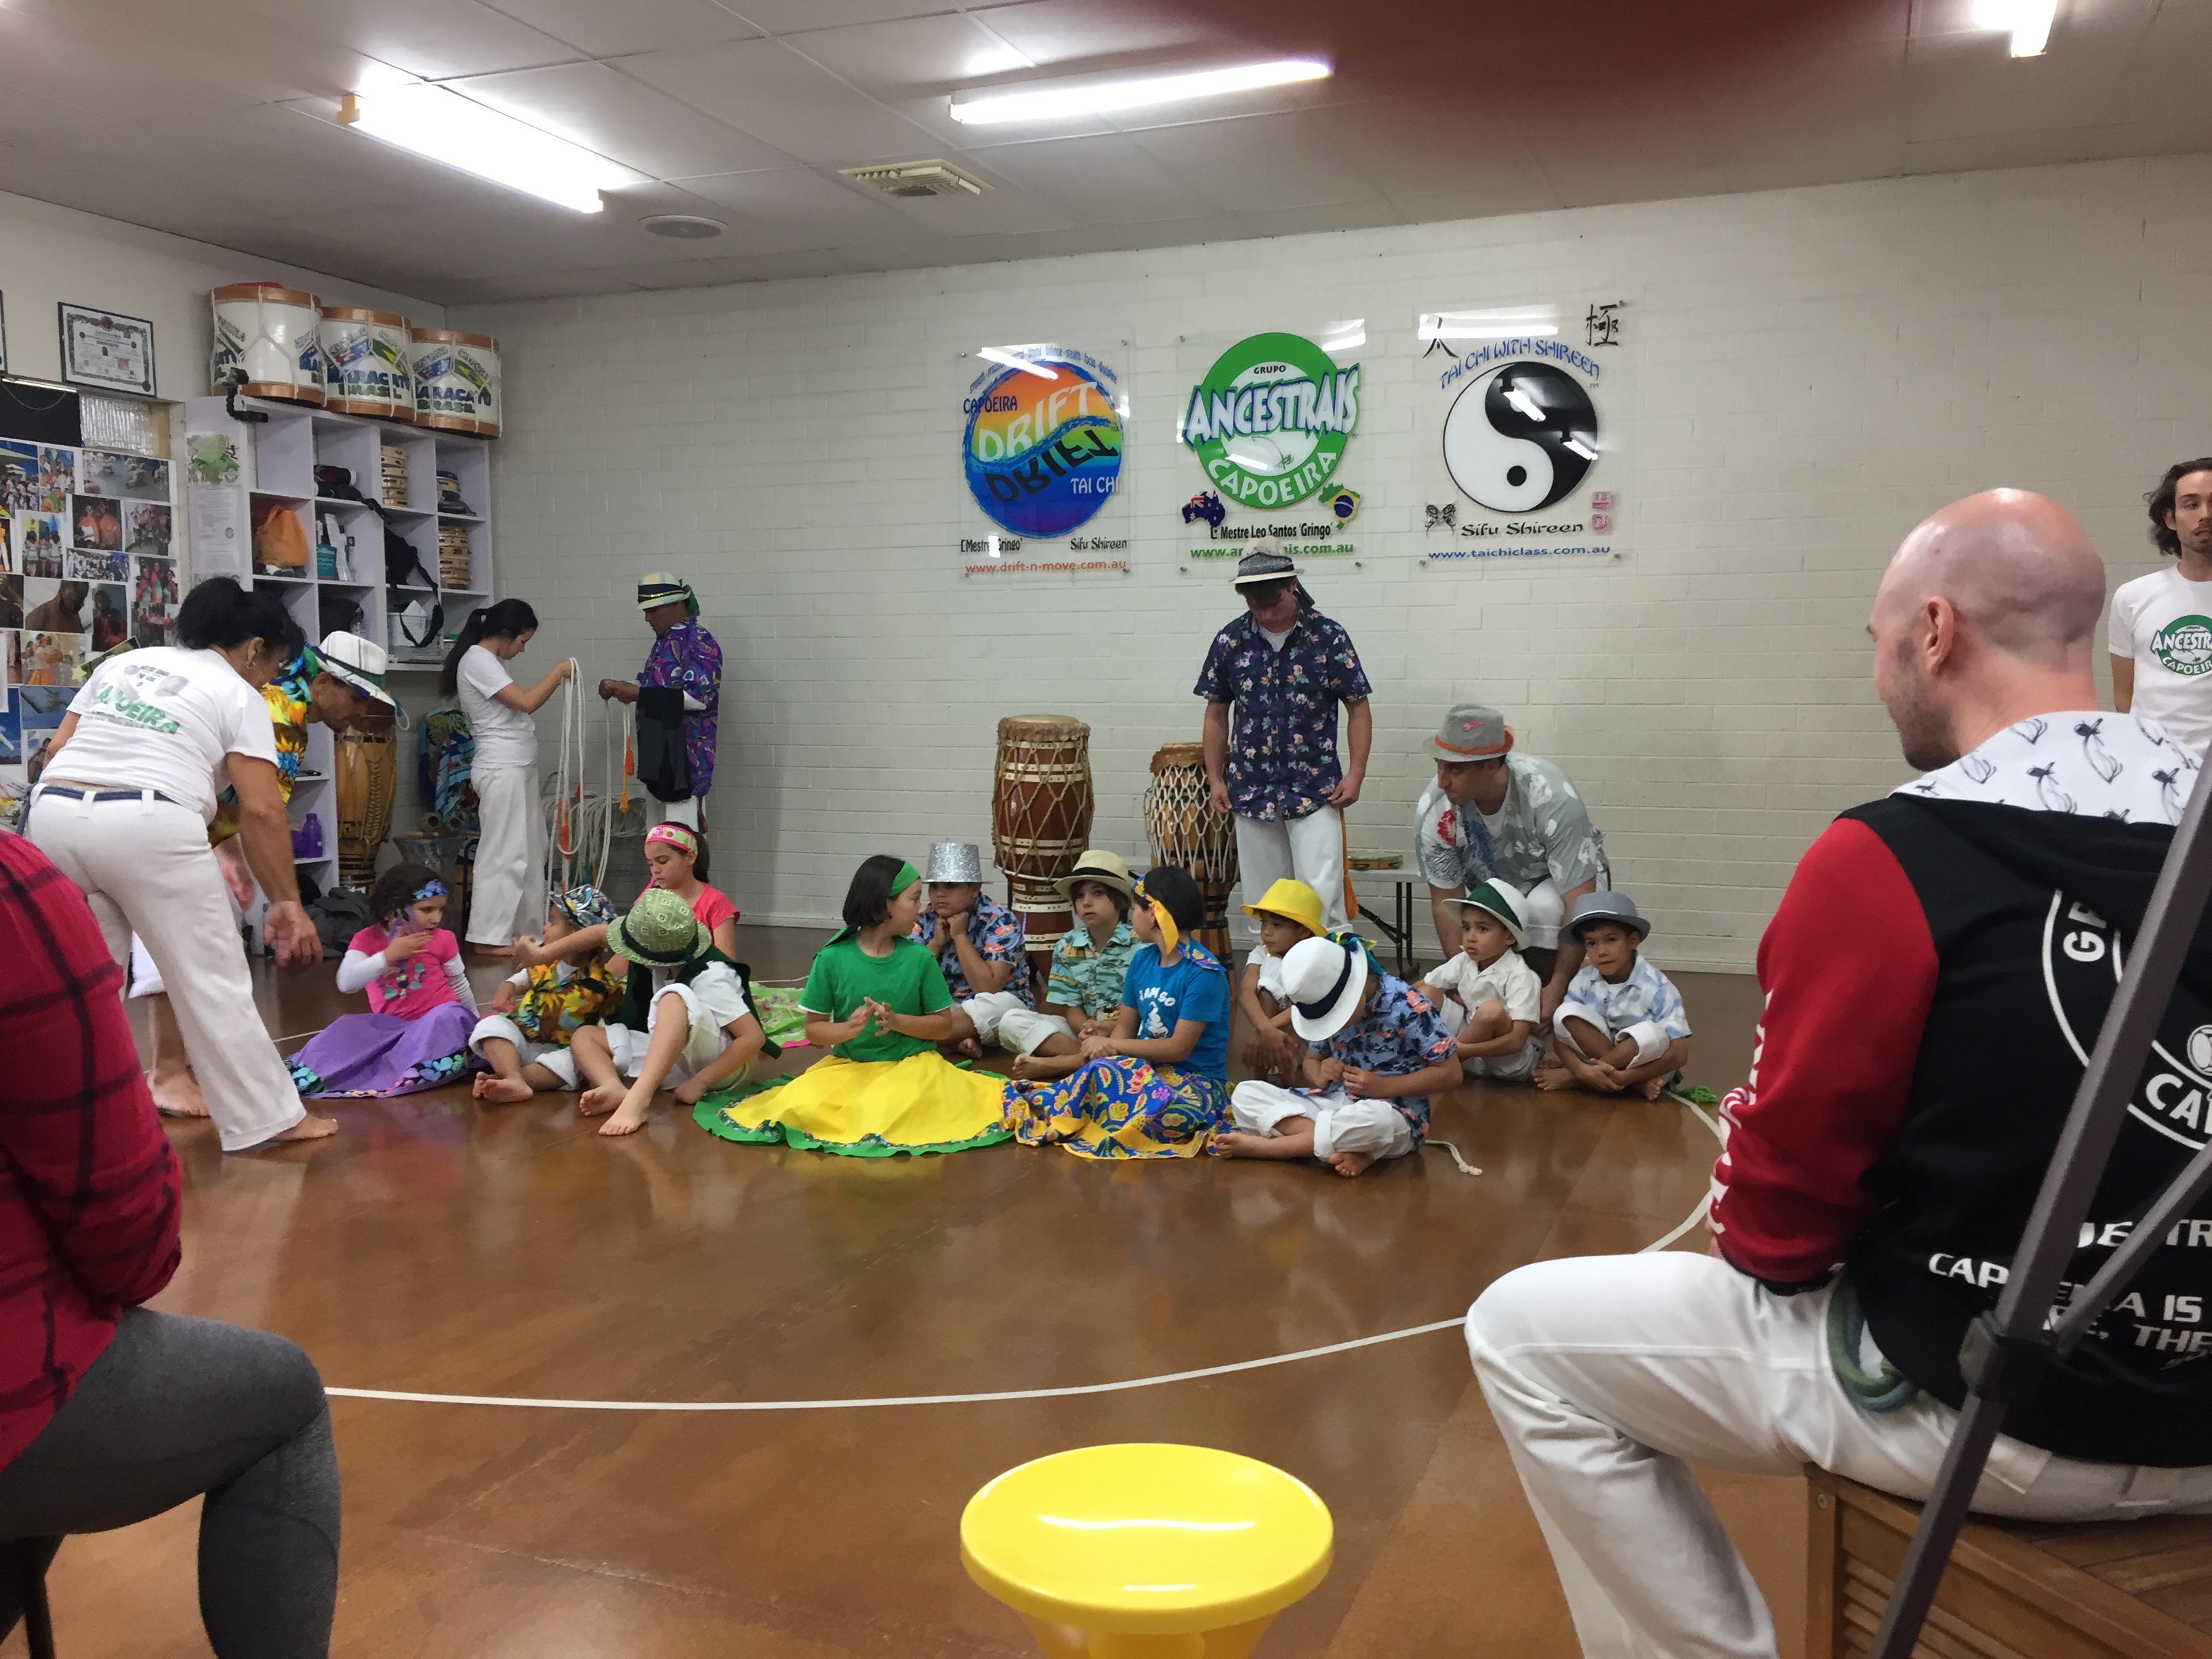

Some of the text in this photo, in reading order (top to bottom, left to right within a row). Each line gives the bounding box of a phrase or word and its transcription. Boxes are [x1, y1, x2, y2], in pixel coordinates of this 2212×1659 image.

[1254, 365, 1286, 375] GRUPO
[1440, 359, 1462, 390] TAI
[1465, 345, 1490, 370] CHI
[1494, 337, 1531, 359] WITH
[964, 395, 1019, 414] CAPOEIRA
[1184, 364, 1359, 448] ANCESTRAIS
[978, 382, 1098, 463] DRIFT
[1070, 476, 1120, 495] TAI CHI
[1208, 451, 1337, 506] CAPOEIRA
[1221, 526, 1249, 539] Mestre
[1252, 525, 1267, 538] Leo
[1269, 524, 1297, 537] Santos
[1461, 522, 1498, 537] Sifu
[1506, 521, 1584, 535] Shireen
[1070, 536, 1128, 550] Sifu Shireen
[1429, 546, 1611, 559] www.taichiclass.com.au
[965, 560, 1127, 573] www.drift-n-move.com.au
[2150, 630, 2212, 654] ANCESTR
[2163, 1294, 2203, 1323] IS
